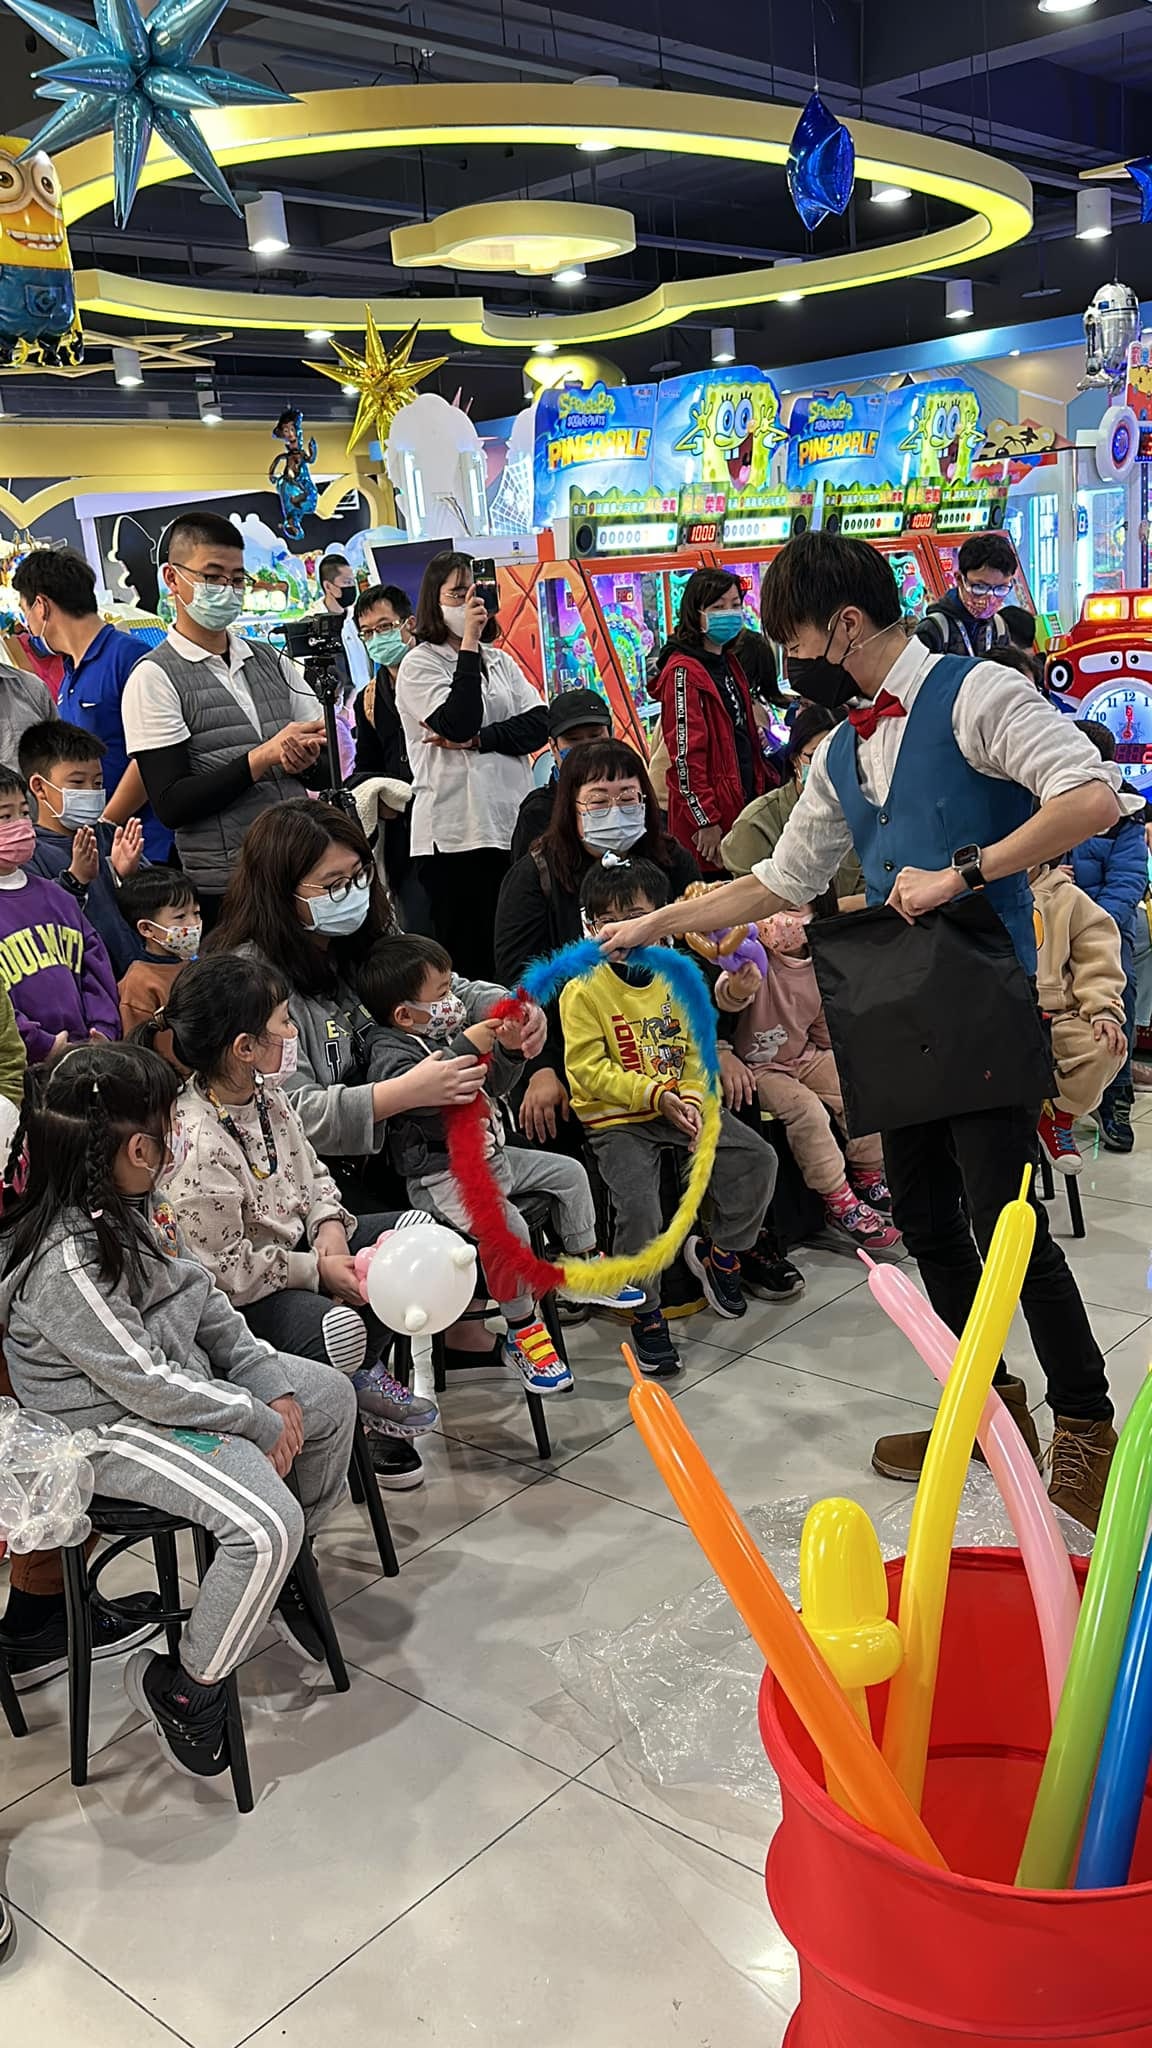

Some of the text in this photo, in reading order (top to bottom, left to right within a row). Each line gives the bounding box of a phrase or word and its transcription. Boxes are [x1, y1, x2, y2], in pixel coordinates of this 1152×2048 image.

[548, 429, 650, 470] PINEAPPLE
[799, 431, 879, 468] PINEAPPLE
[910, 513, 933, 528] 1000
[690, 524, 716, 542] 1000
[1108, 697, 1117, 708] 11
[1124, 692, 1136, 702] 12
[677, 691, 685, 719] TOMMY
[1096, 711, 1107, 722] 10
[1124, 766, 1131, 775] 6
[1140, 765, 1147, 775] 5
